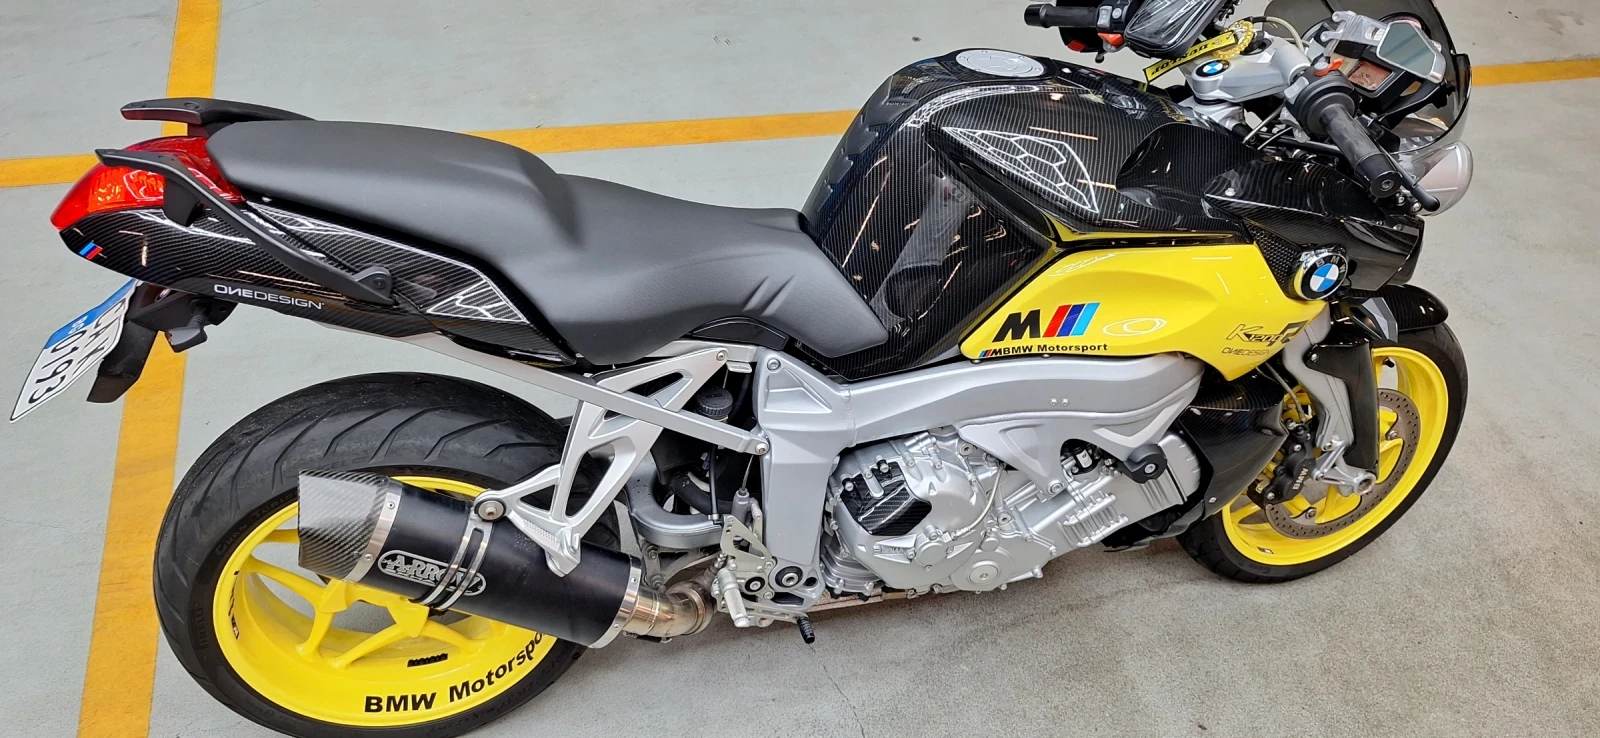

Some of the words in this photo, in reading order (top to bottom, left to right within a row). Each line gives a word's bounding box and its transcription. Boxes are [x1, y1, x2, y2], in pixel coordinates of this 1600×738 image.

[1315, 255, 1346, 274] BMW
[214, 284, 323, 310] ONEDESIGN
[1037, 343, 1108, 353] Motorsport
[28, 329, 88, 404] 0193
[1292, 467, 1309, 490] BMW
[364, 692, 437, 713] BMW
[449, 632, 546, 703] Motorspo
